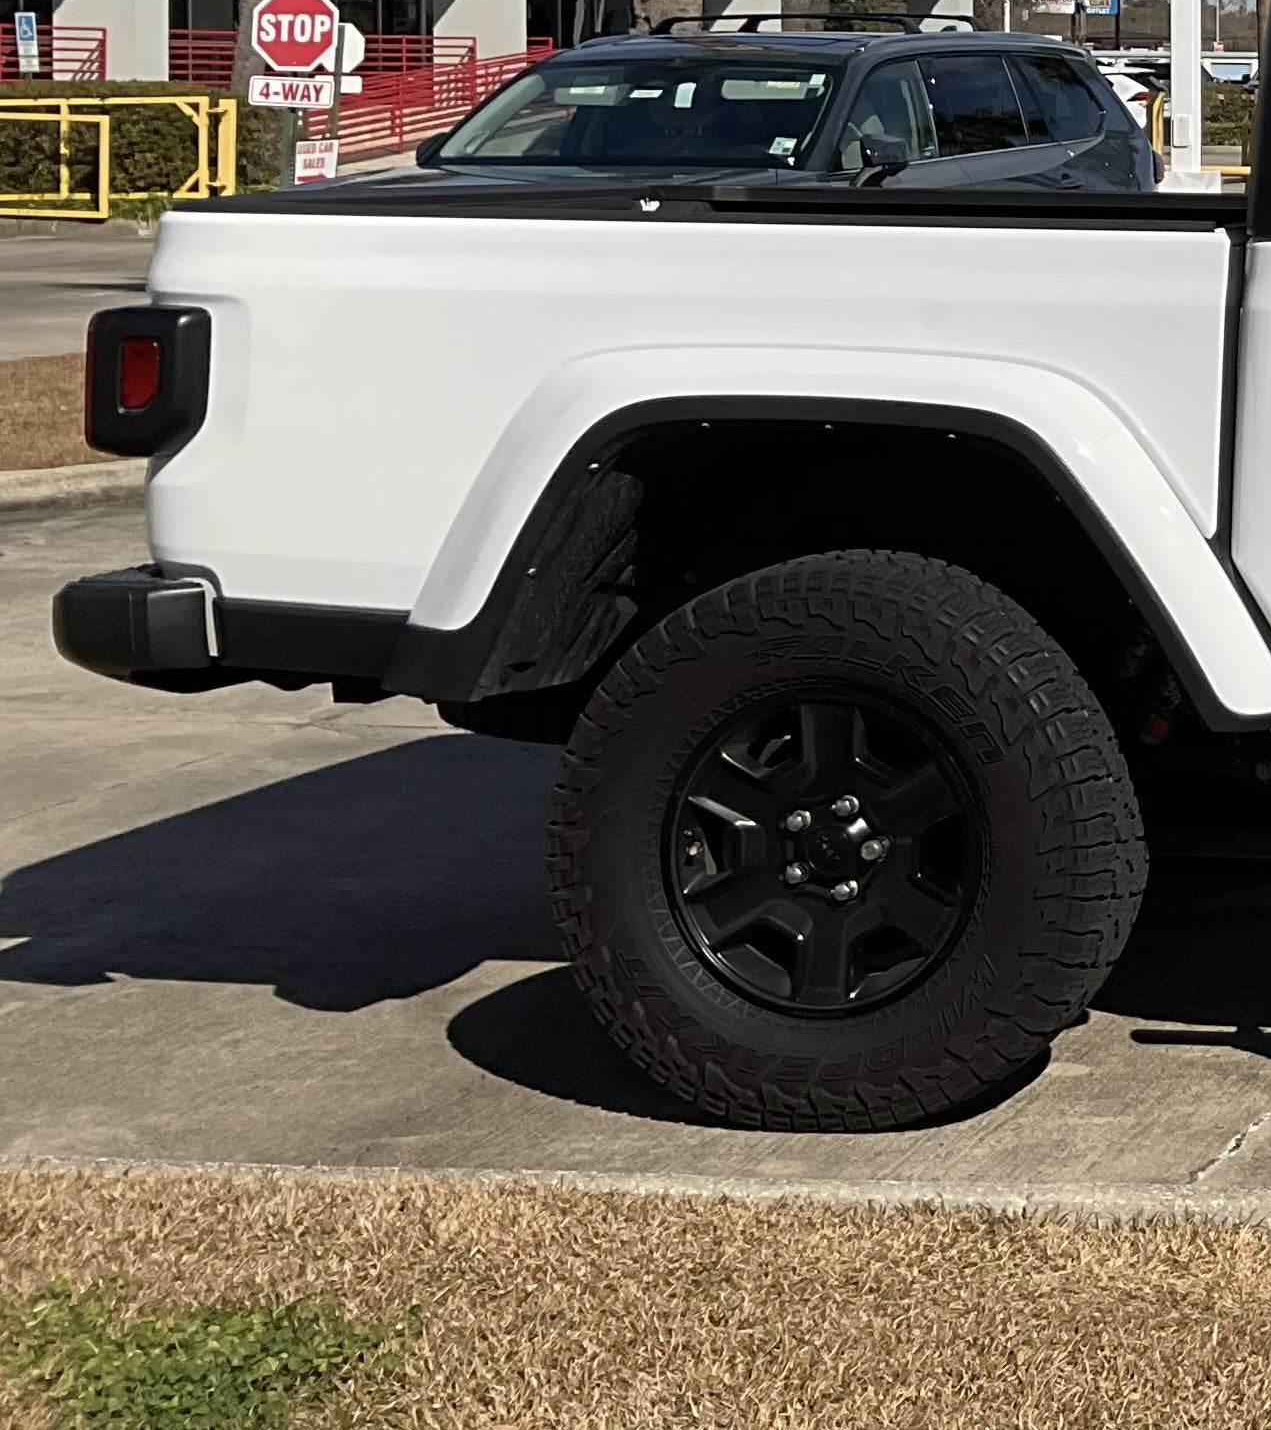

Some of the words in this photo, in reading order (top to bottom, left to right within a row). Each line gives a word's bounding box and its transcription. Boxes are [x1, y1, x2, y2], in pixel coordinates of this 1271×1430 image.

[259, 13, 332, 44] STOP
[258, 79, 324, 104] 4-WAY
[318, 142, 333, 153] CAR
[303, 158, 325, 169] SALES
